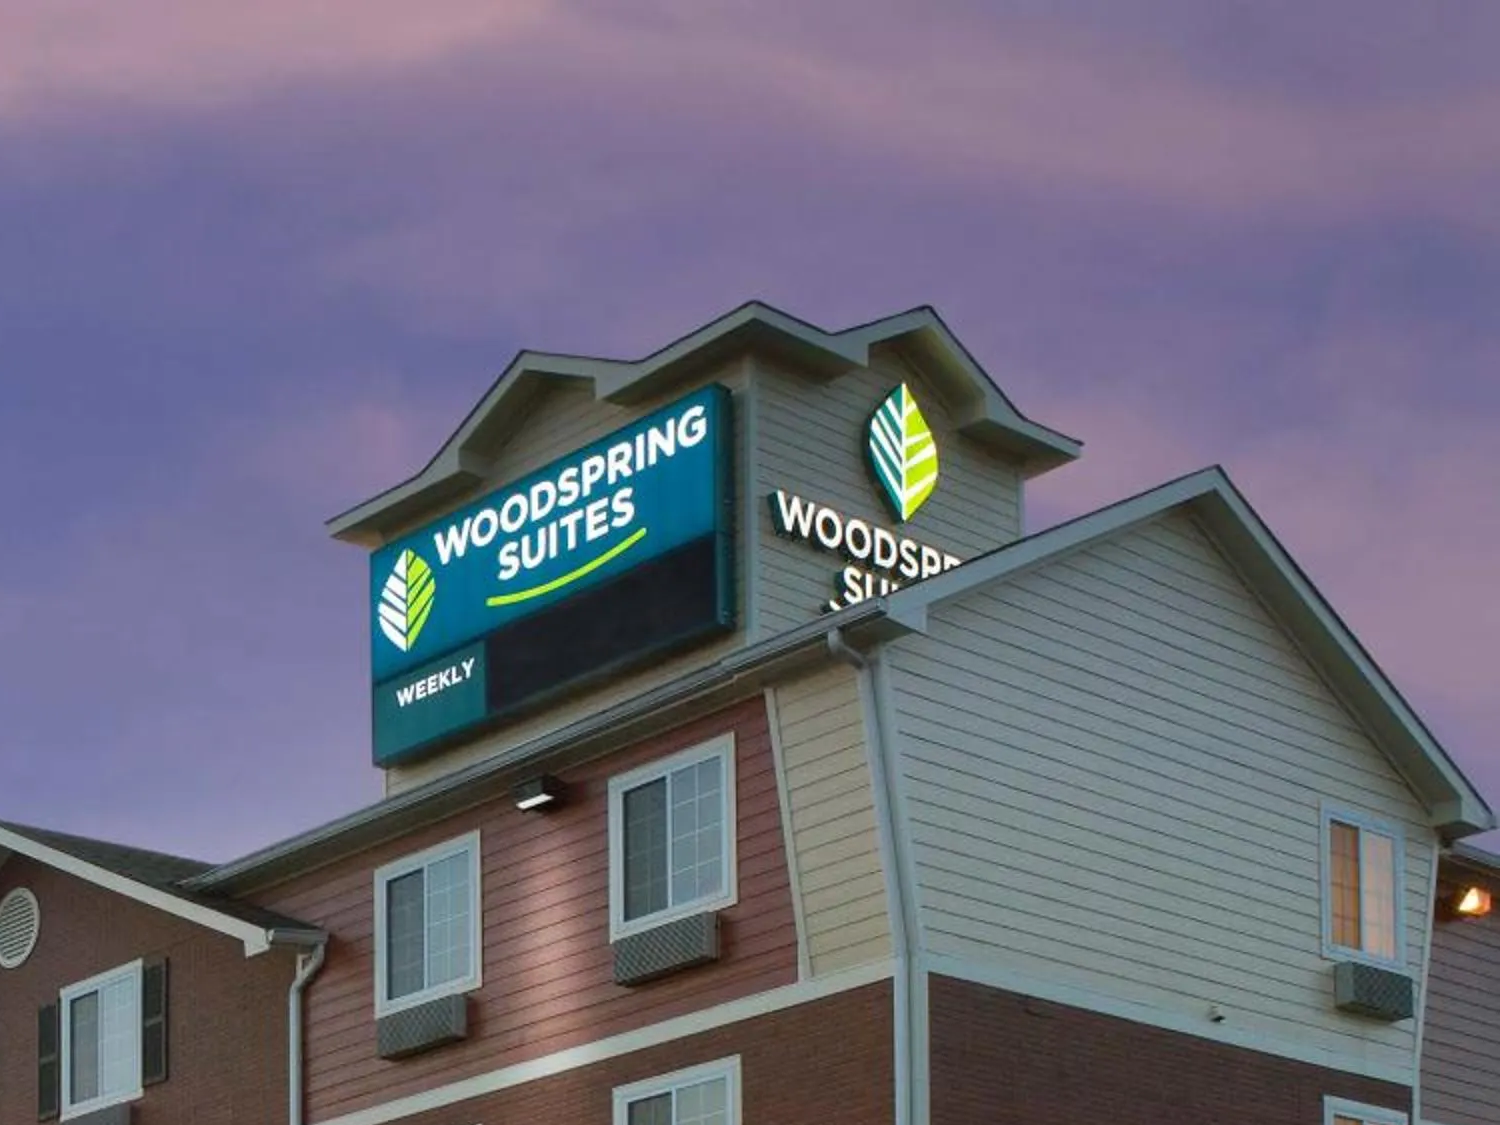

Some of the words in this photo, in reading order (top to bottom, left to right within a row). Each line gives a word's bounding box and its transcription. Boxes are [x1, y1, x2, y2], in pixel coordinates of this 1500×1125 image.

[434, 405, 708, 566] WOODSPRING
[497, 488, 635, 580] SUITES
[775, 489, 962, 579] WOODSP
[396, 658, 475, 707] WEEKLY
